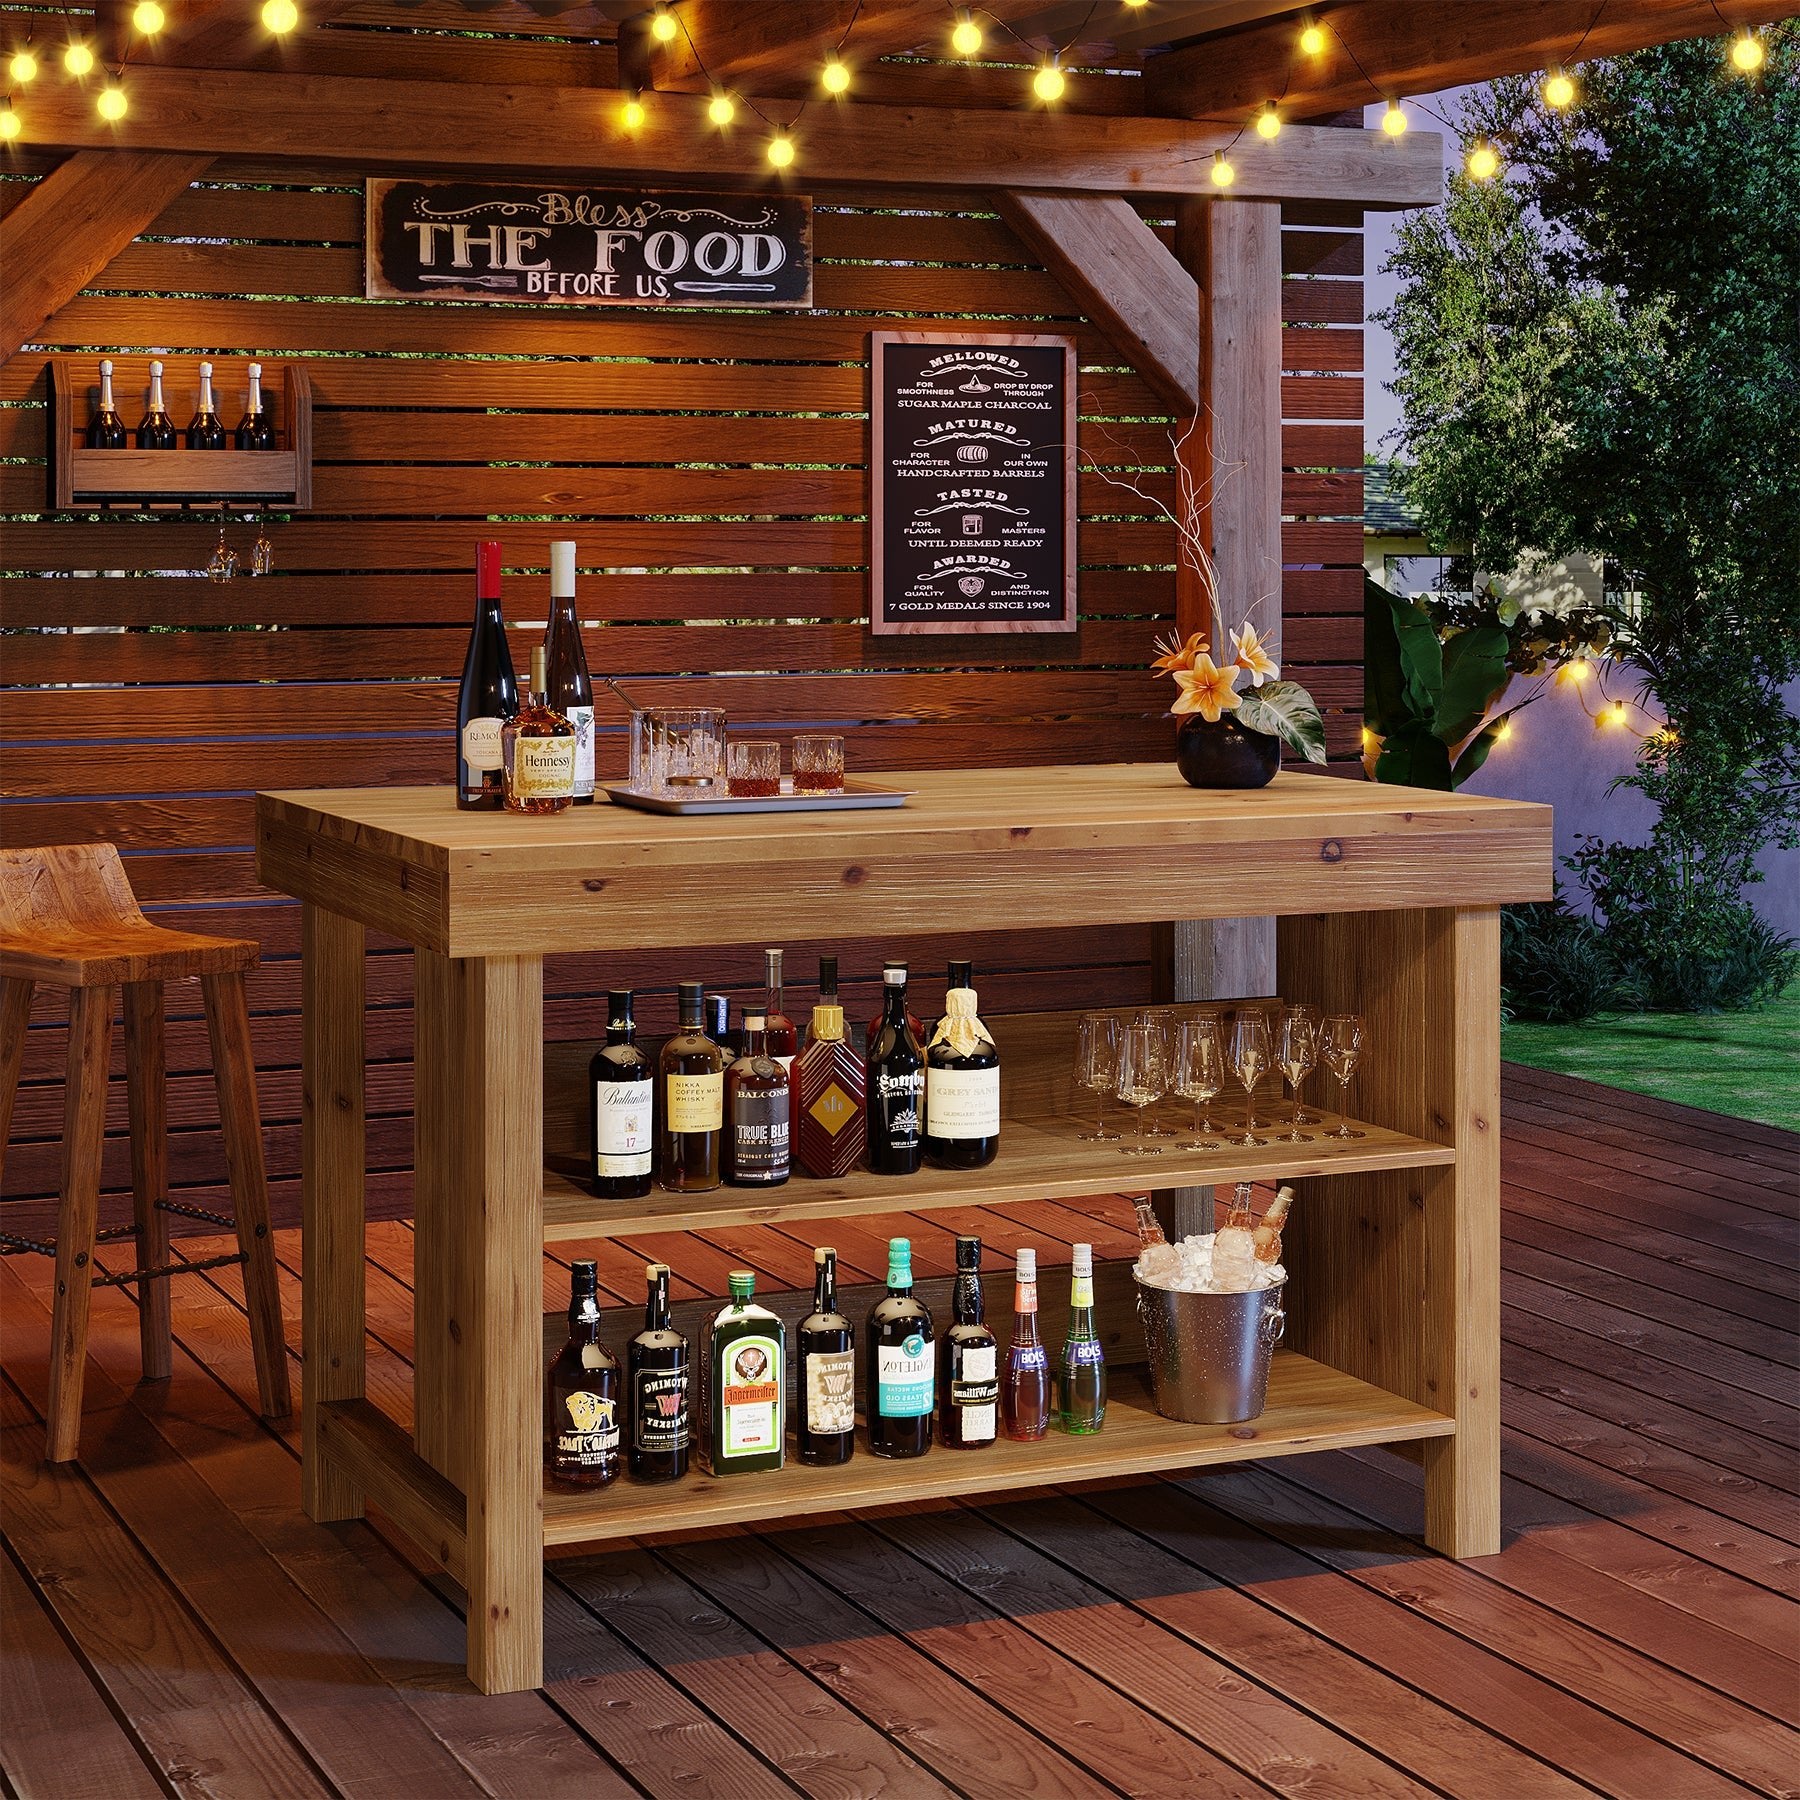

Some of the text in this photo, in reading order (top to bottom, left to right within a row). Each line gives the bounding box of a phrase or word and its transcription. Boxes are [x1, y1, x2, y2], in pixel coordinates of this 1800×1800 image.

[537, 193, 661, 228] Bless
[404, 221, 787, 277] THE FOOD
[527, 271, 671, 299] BEFORE US,
[929, 351, 1020, 368] MELLOWED
[897, 400, 1053, 410] SUGAR MAPLE CHARCOAL
[927, 419, 1018, 436] MATURED
[897, 469, 1045, 478] HANDCRAFTED BARRELS
[936, 488, 1009, 502] TASTED
[908, 539, 1044, 548] UNTIL DEEMED READY
[933, 555, 1012, 570] AWARDED
[889, 601, 1051, 611] 7 GOLD MEDALS SINCE 1904
[525, 754, 571, 768] Hennessy
[706, 1086, 721, 1094] MALT
[936, 1087, 971, 1096] GREY
[737, 1121, 789, 1140] TRUE BLUE
[626, 1137, 636, 1148] 17
[1021, 1350, 1045, 1364] BOLS
[1077, 1345, 1101, 1358] BOLS
